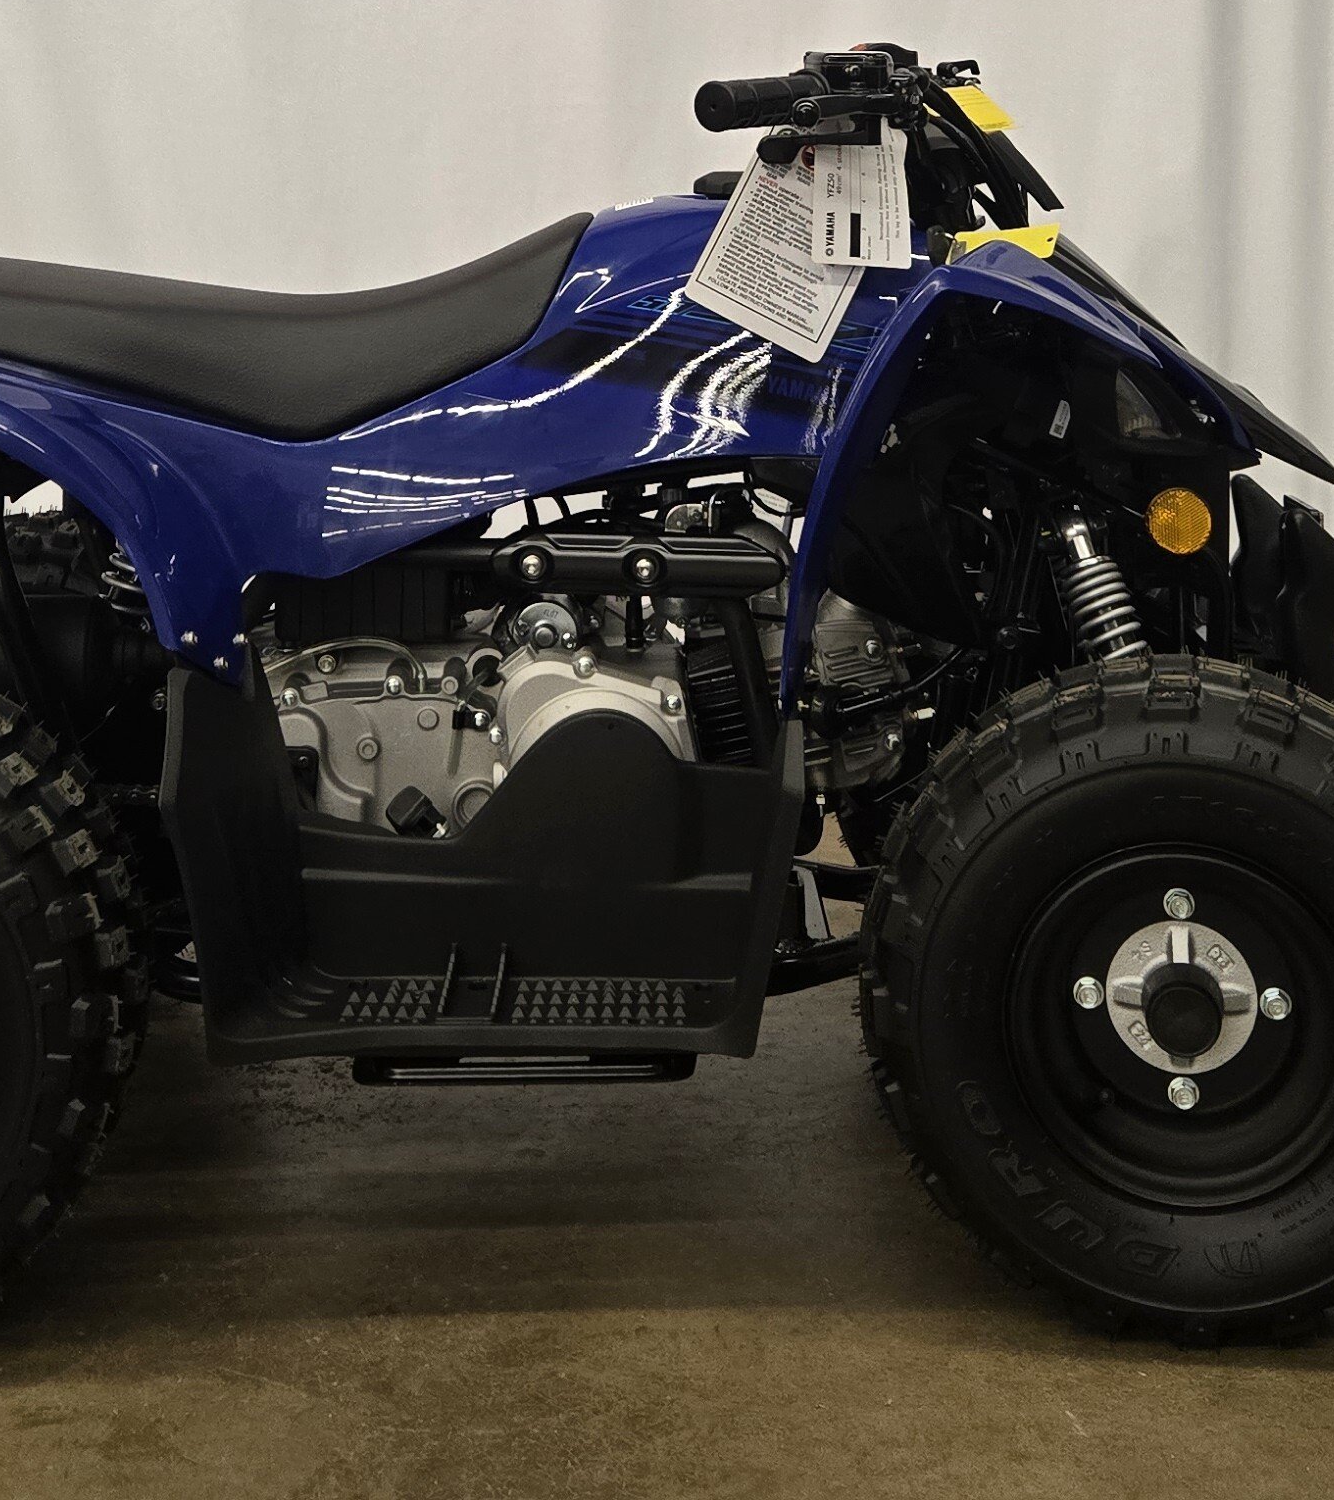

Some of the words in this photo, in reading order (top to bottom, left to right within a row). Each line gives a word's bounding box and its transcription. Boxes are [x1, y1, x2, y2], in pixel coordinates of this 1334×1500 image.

[757, 174, 778, 188] NEVER
[826, 173, 834, 198] YFZ50
[758, 182, 777, 194] without
[777, 192, 794, 203] proper
[794, 201, 814, 214] training
[825, 211, 835, 246] YAMAHA
[742, 237, 760, 249] proper
[759, 246, 775, 257] riding
[707, 276, 729, 289] FOLLOW
[738, 291, 775, 313] INSTRUCTIONS
[775, 310, 786, 319] AND
[716, 274, 736, 287] LOCATE
[736, 284, 748, 293] AND
[748, 290, 762, 300] READ
